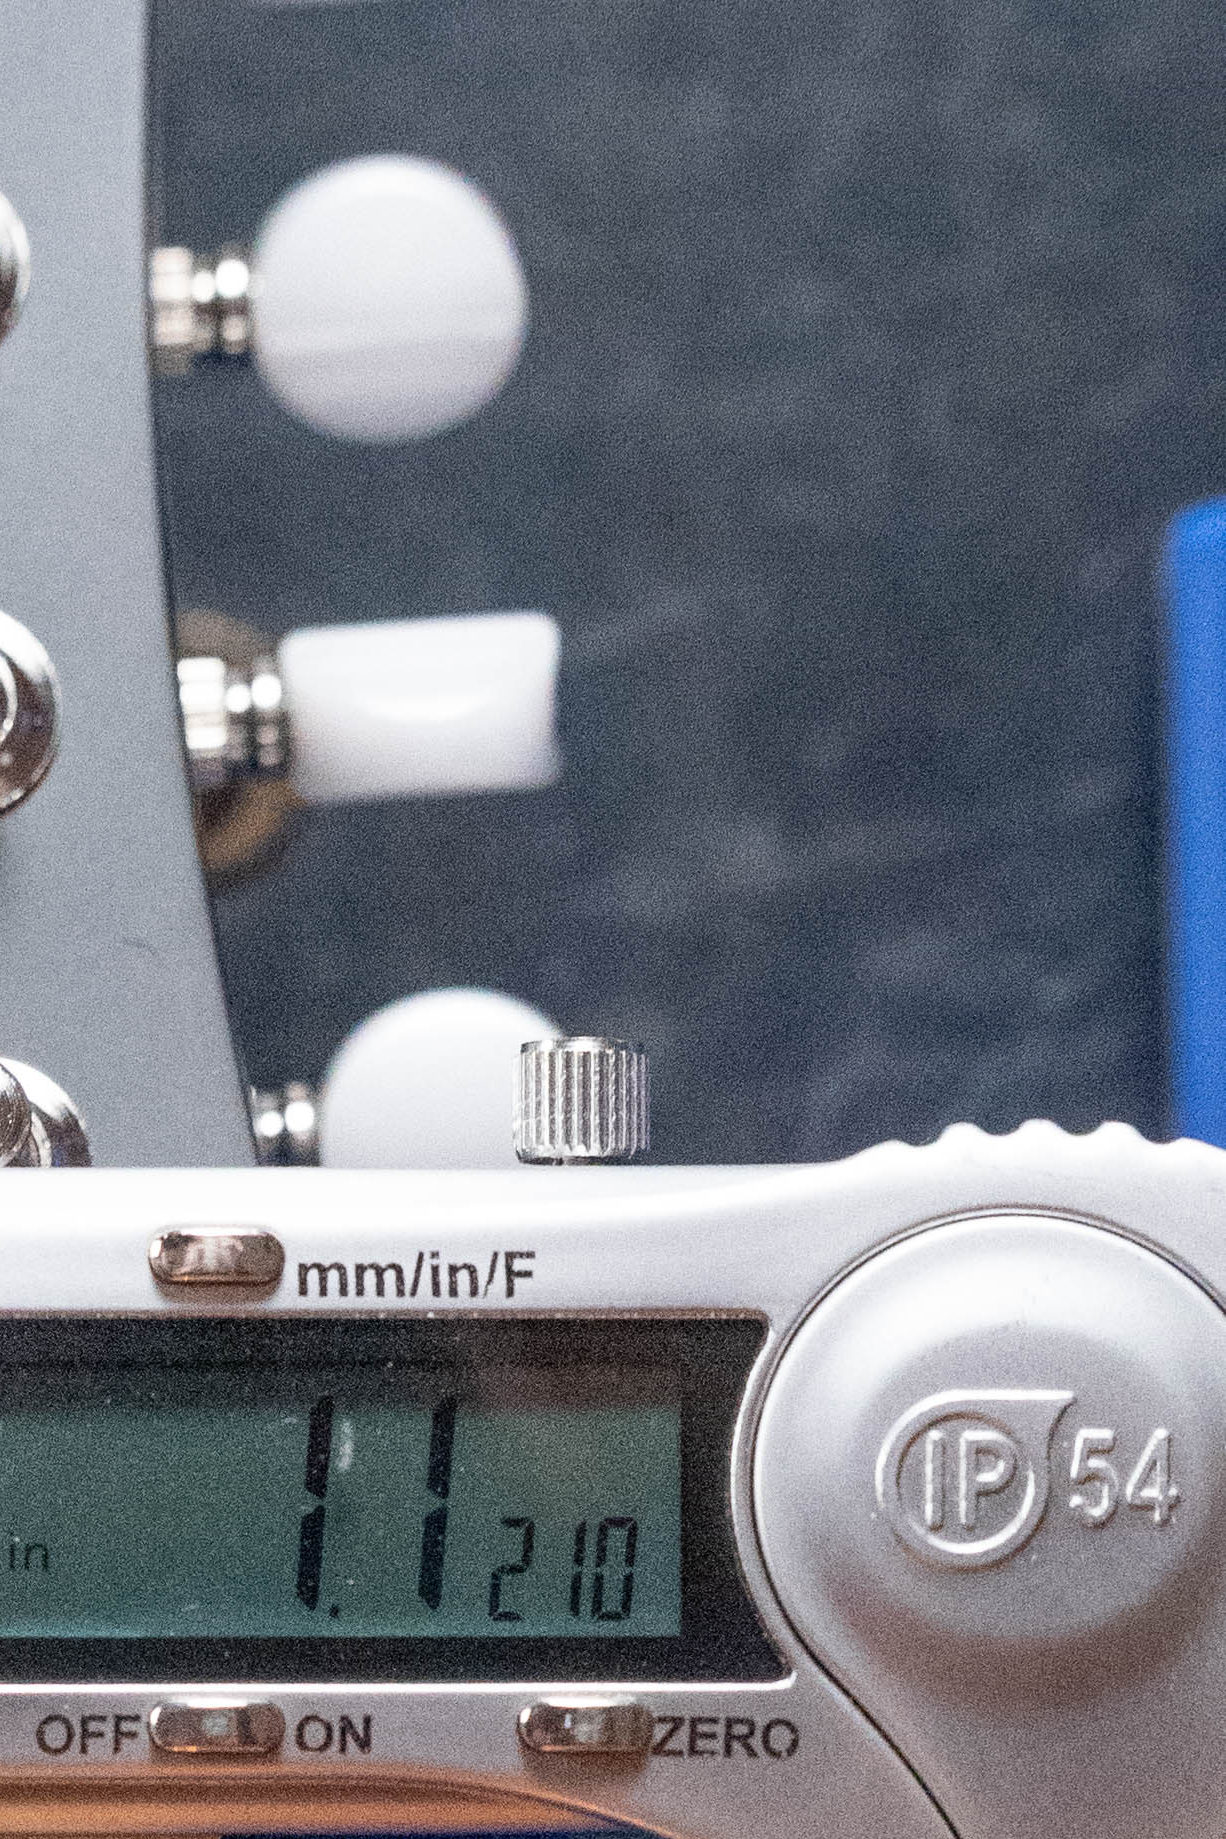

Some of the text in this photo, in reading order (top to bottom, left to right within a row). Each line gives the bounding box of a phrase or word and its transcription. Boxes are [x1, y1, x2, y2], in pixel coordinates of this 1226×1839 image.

[297, 1250, 536, 1299] mm/in/F
[923, 1427, 1182, 1532] IP 54
[9, 1535, 50, 1572] in
[35, 1714, 141, 1755] OFF
[294, 1714, 374, 1754] ON
[652, 1715, 800, 1758] ZERO
